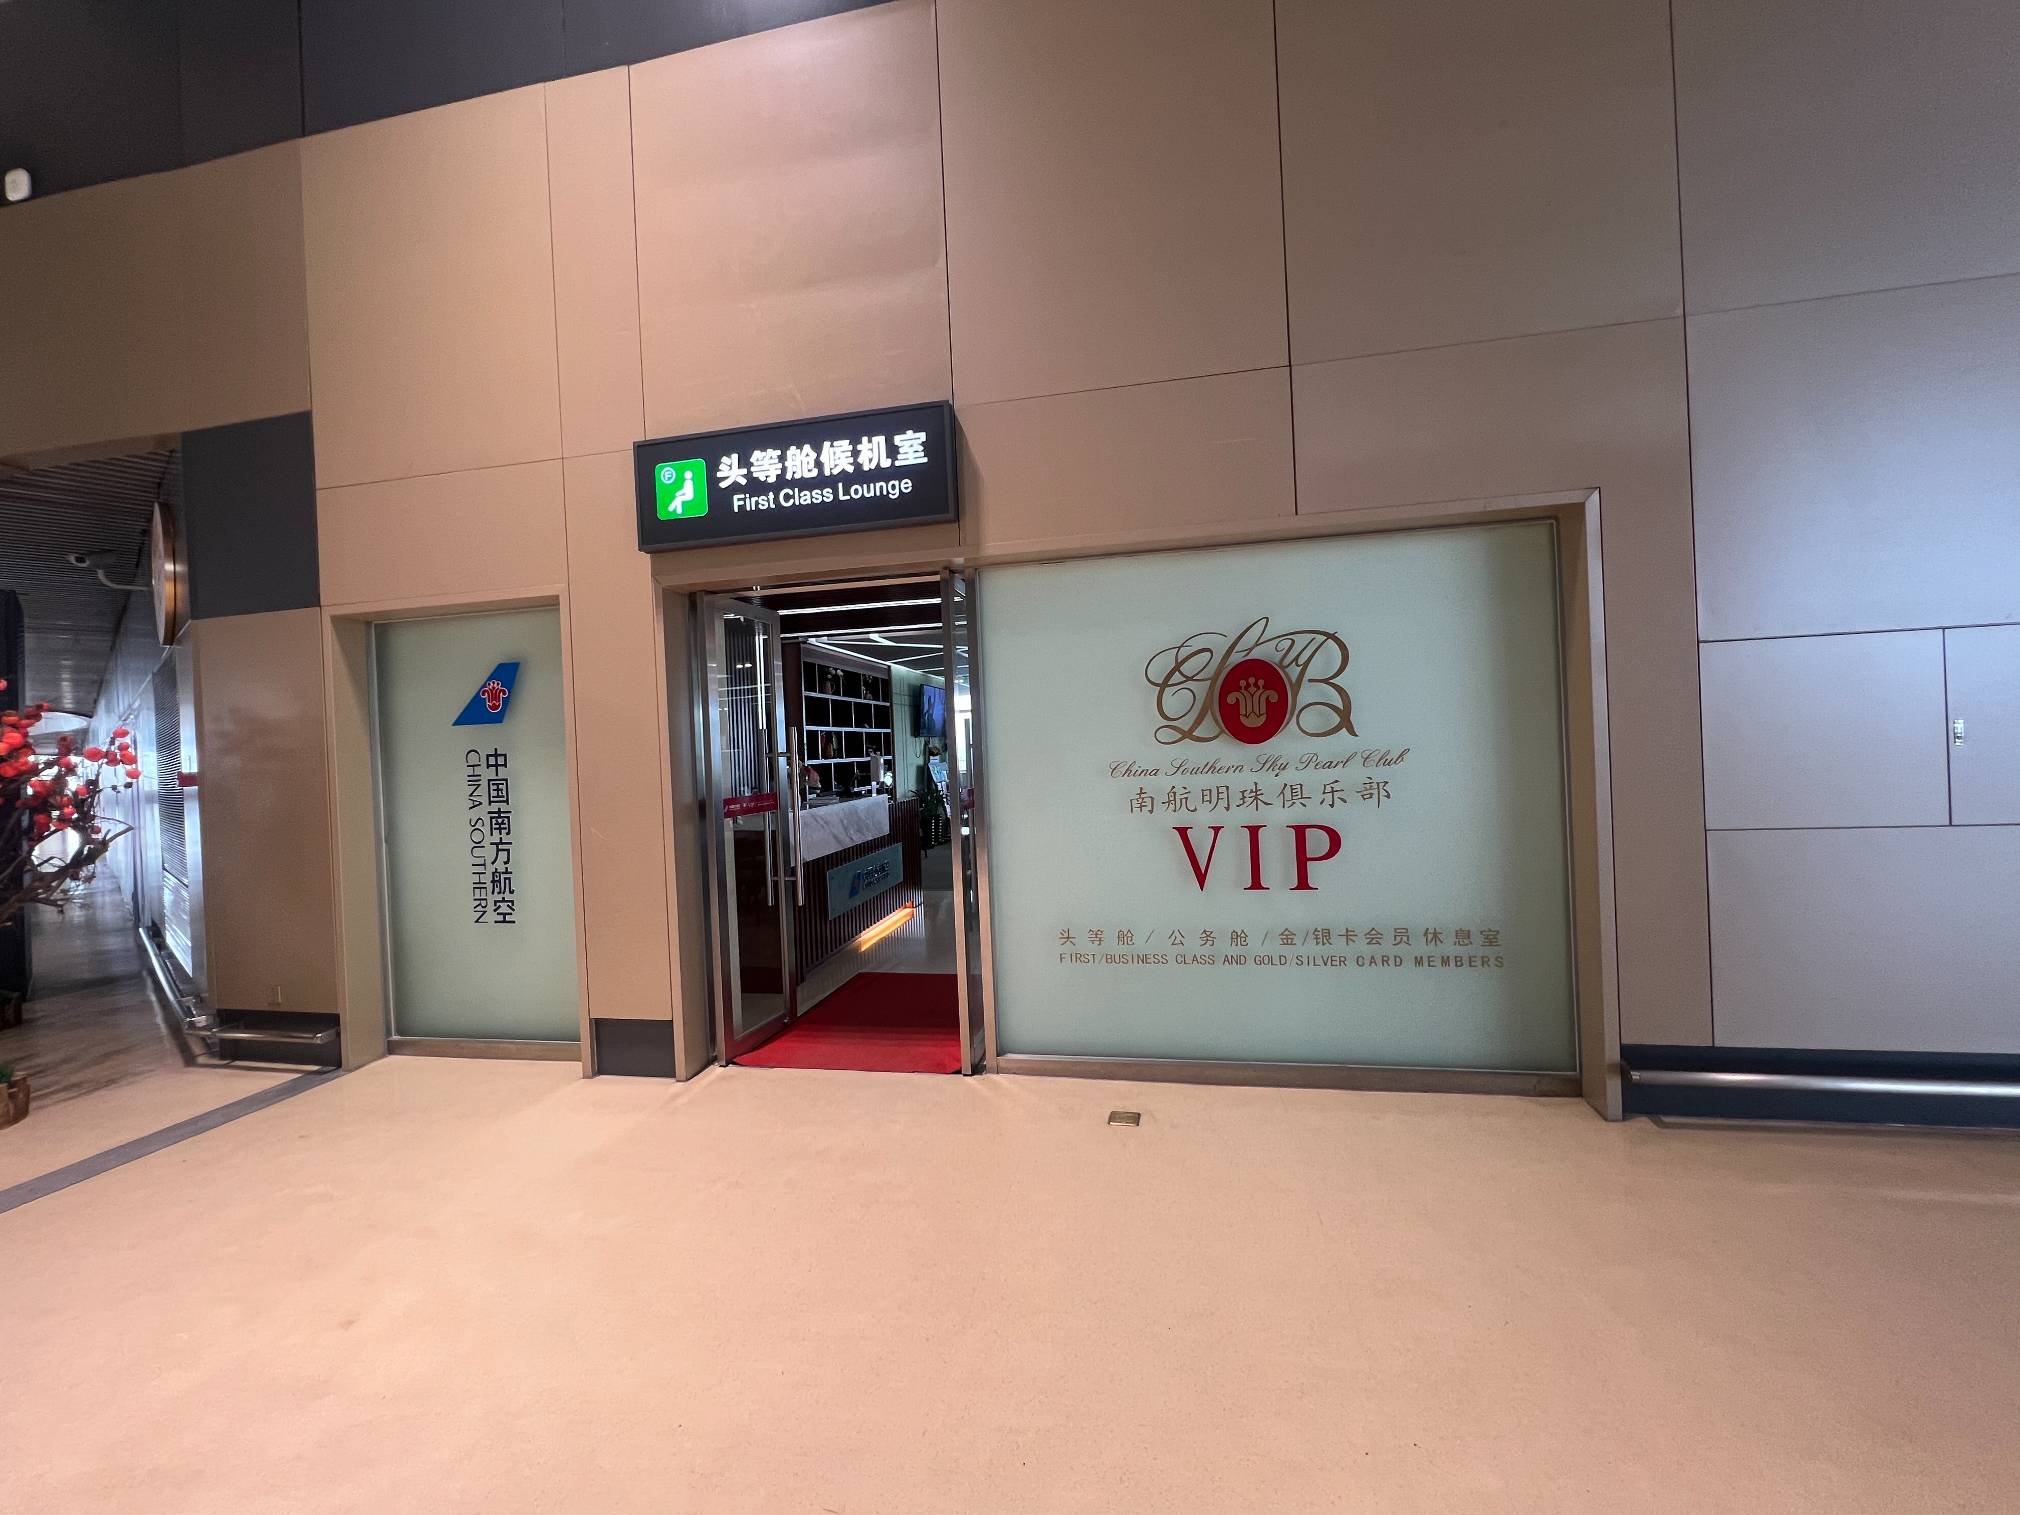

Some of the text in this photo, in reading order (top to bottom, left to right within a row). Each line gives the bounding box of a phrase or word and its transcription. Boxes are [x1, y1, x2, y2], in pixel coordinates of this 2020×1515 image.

[716, 429, 929, 489] 头等舱候机室
[733, 478, 913, 513] First Class Lounge
[1109, 747, 1411, 779] China Southern Sky Pearl Club
[1129, 776, 1393, 815] 南航明珠俱乐部
[465, 749, 489, 924] CHINA SOUTHERN
[485, 747, 516, 924] 中国南方航空
[1172, 823, 1343, 893] VIP
[1059, 952, 1505, 968] FIRST/BUSINESS CLASS AND GOLD/SILVER CARD MEMBERS
